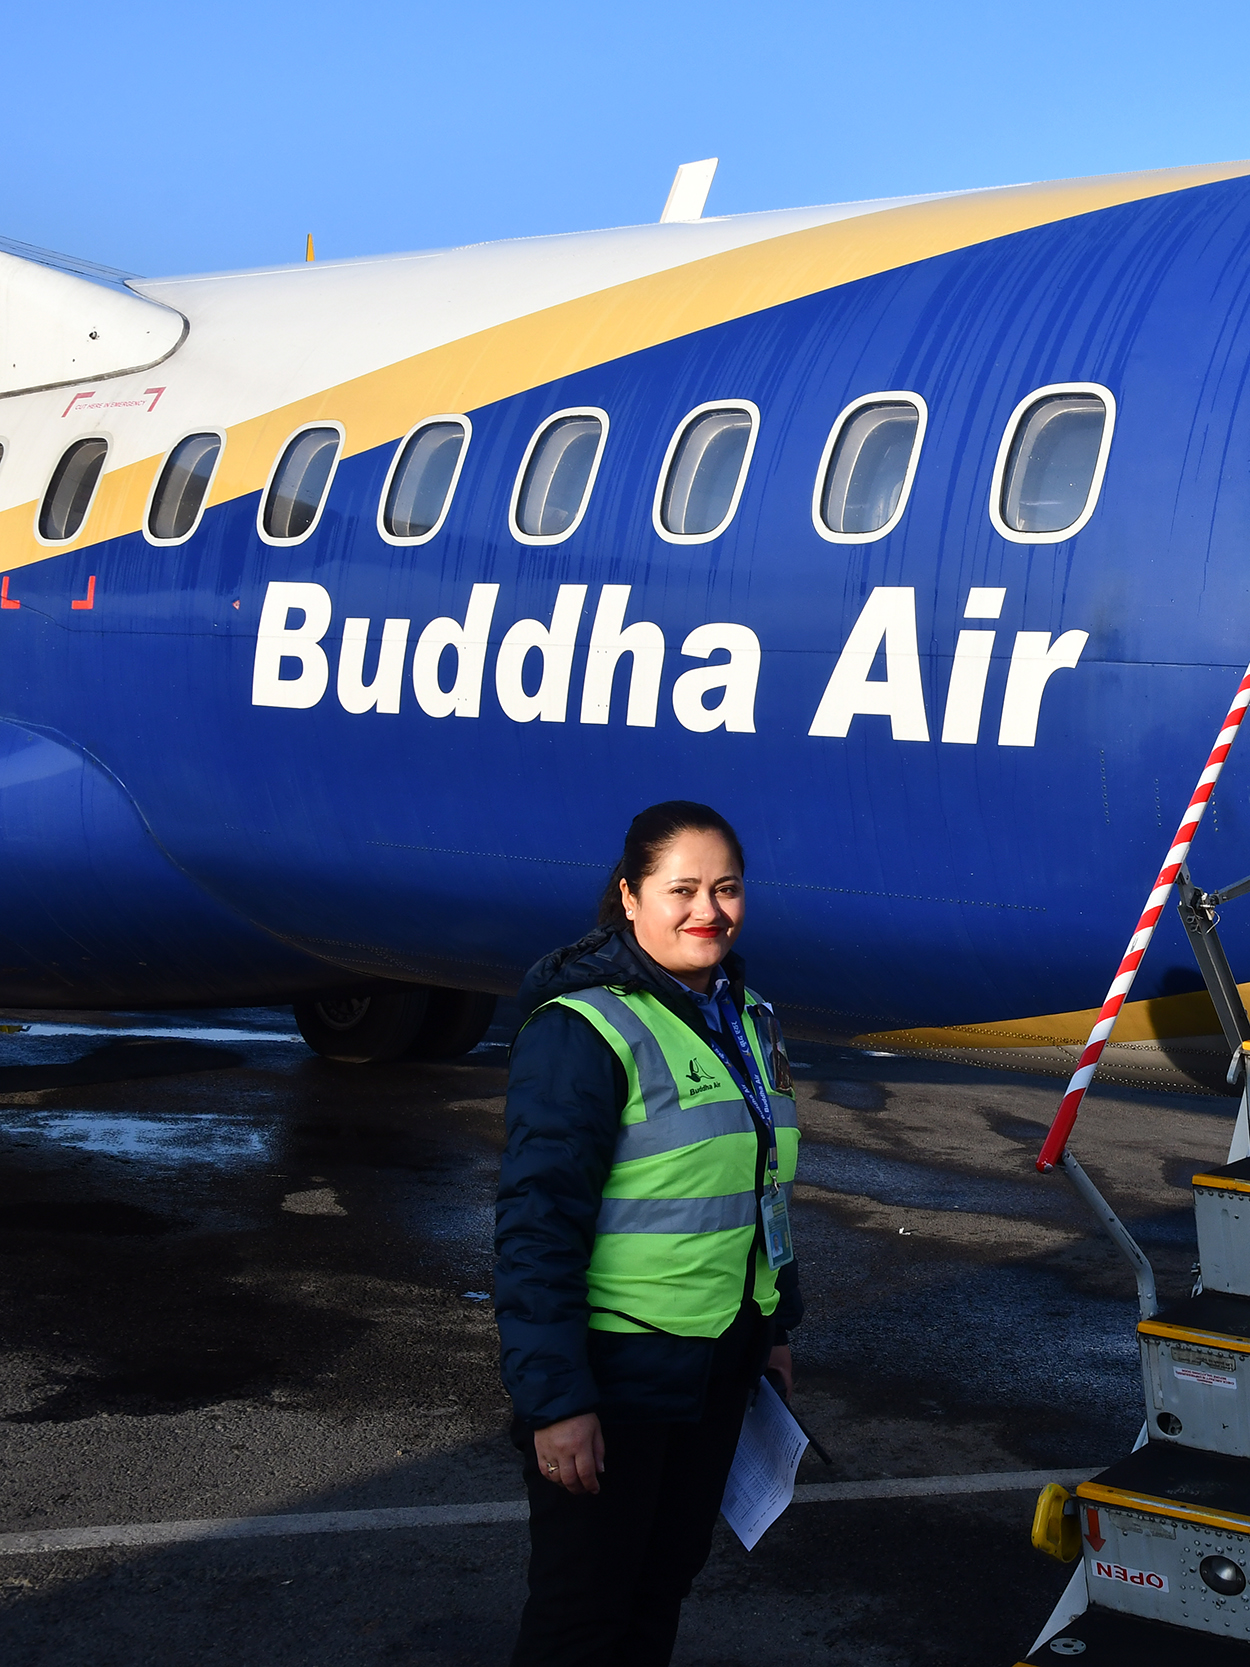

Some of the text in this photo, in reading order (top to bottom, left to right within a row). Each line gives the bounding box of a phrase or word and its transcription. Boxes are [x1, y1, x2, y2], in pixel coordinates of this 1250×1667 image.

[251, 581, 1091, 748] Buddha Air
[689, 1081, 722, 1096] Buddha Air
[741, 1084, 750, 1094] Air
[754, 1074, 769, 1113] Buddha Air
[1096, 1561, 1164, 1589] OPEN
